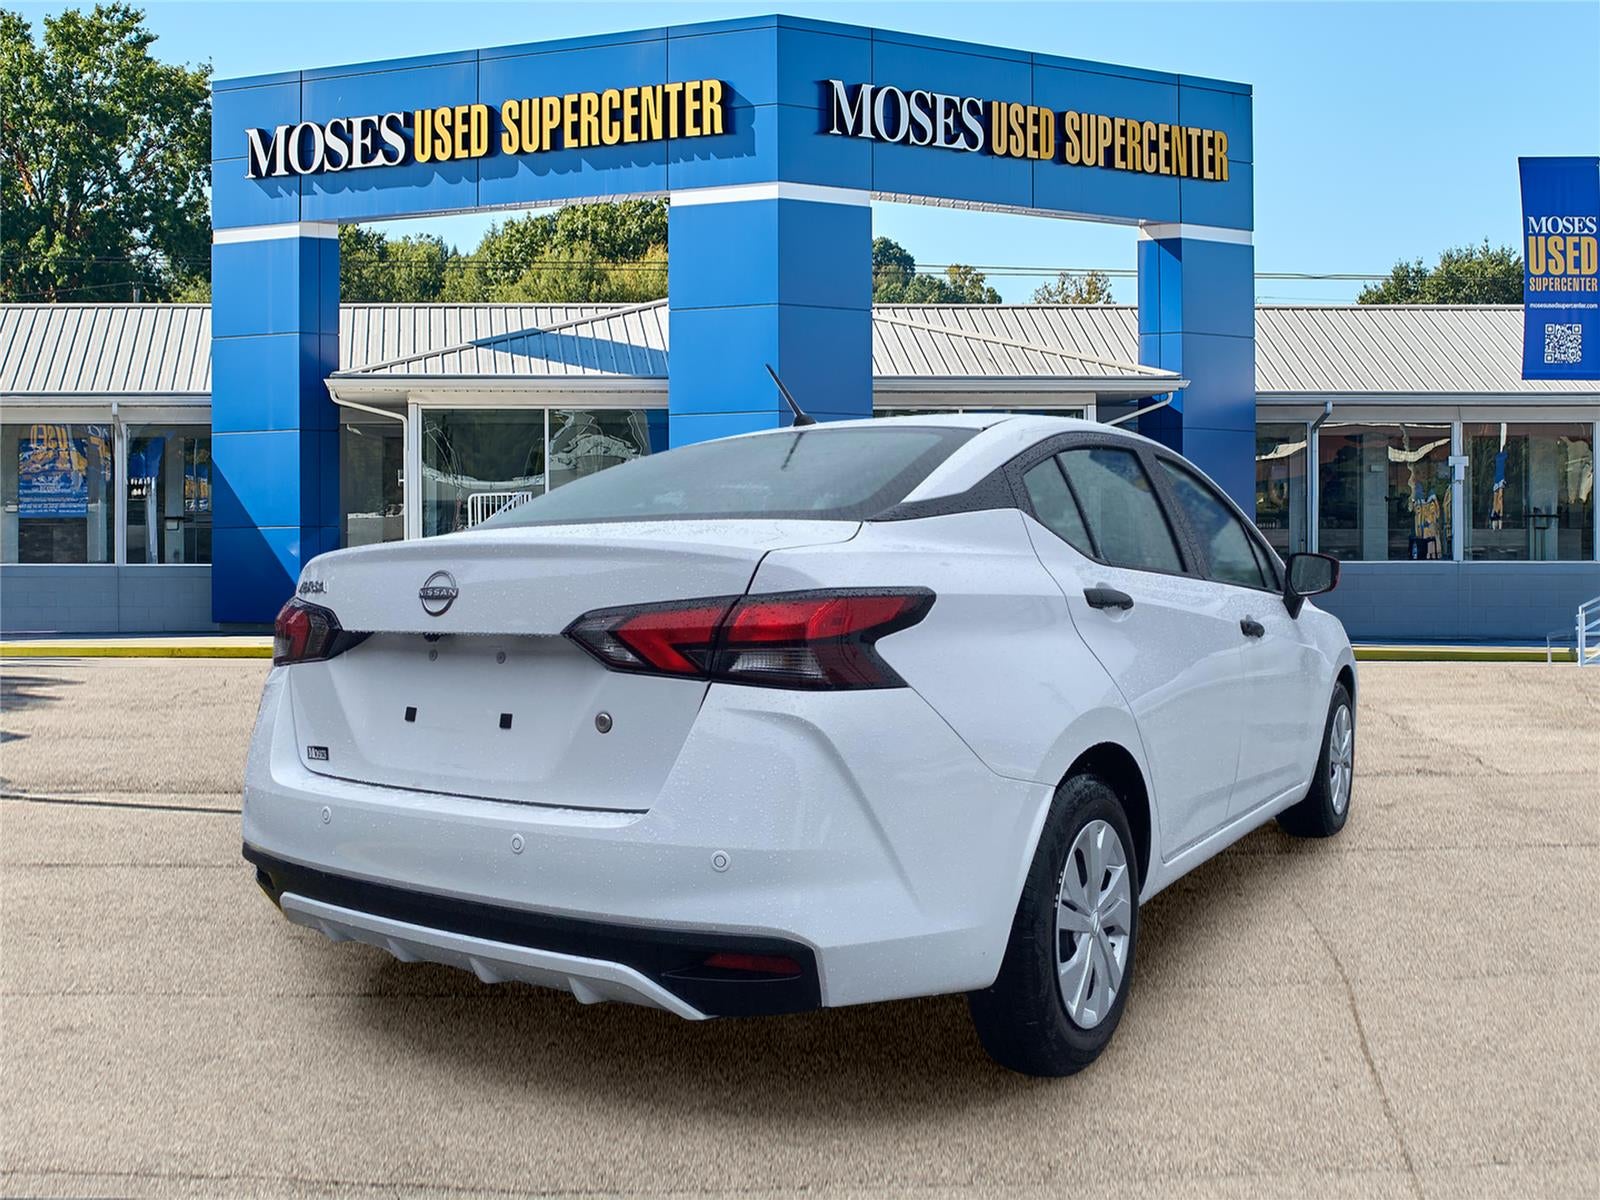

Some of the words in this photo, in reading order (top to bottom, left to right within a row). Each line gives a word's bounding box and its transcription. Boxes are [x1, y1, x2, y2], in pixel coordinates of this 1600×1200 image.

[244, 111, 407, 180] MOSES
[412, 103, 489, 163] USED
[499, 78, 725, 156] SUPERCENTER
[828, 79, 985, 153] MOSES
[991, 100, 1056, 161] USED
[1064, 110, 1230, 182] SUPERCENTER
[1528, 216, 1597, 234] MOSES
[1529, 235, 1598, 275] USED
[1529, 277, 1598, 291] SUPERCENTER
[419, 588, 458, 599] NISSAN
